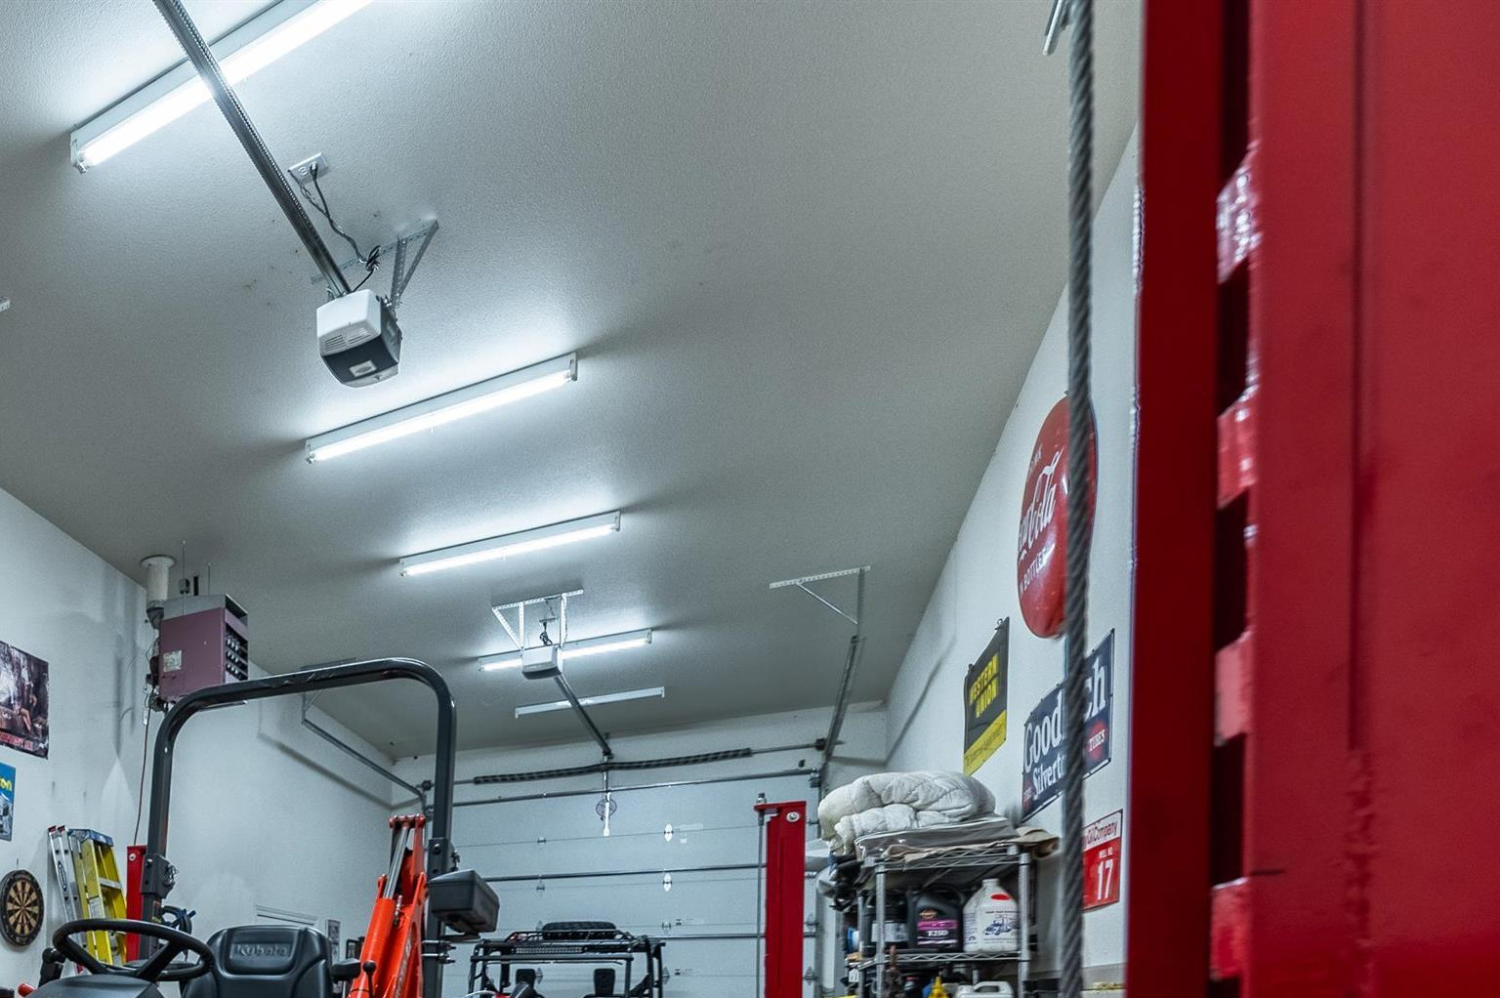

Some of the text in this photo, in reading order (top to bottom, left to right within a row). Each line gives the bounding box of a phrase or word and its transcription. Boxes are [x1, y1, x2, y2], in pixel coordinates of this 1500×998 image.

[1024, 655, 1106, 774] Goodch
[1097, 858, 1114, 901] 17
[236, 944, 288, 958] Kubota
